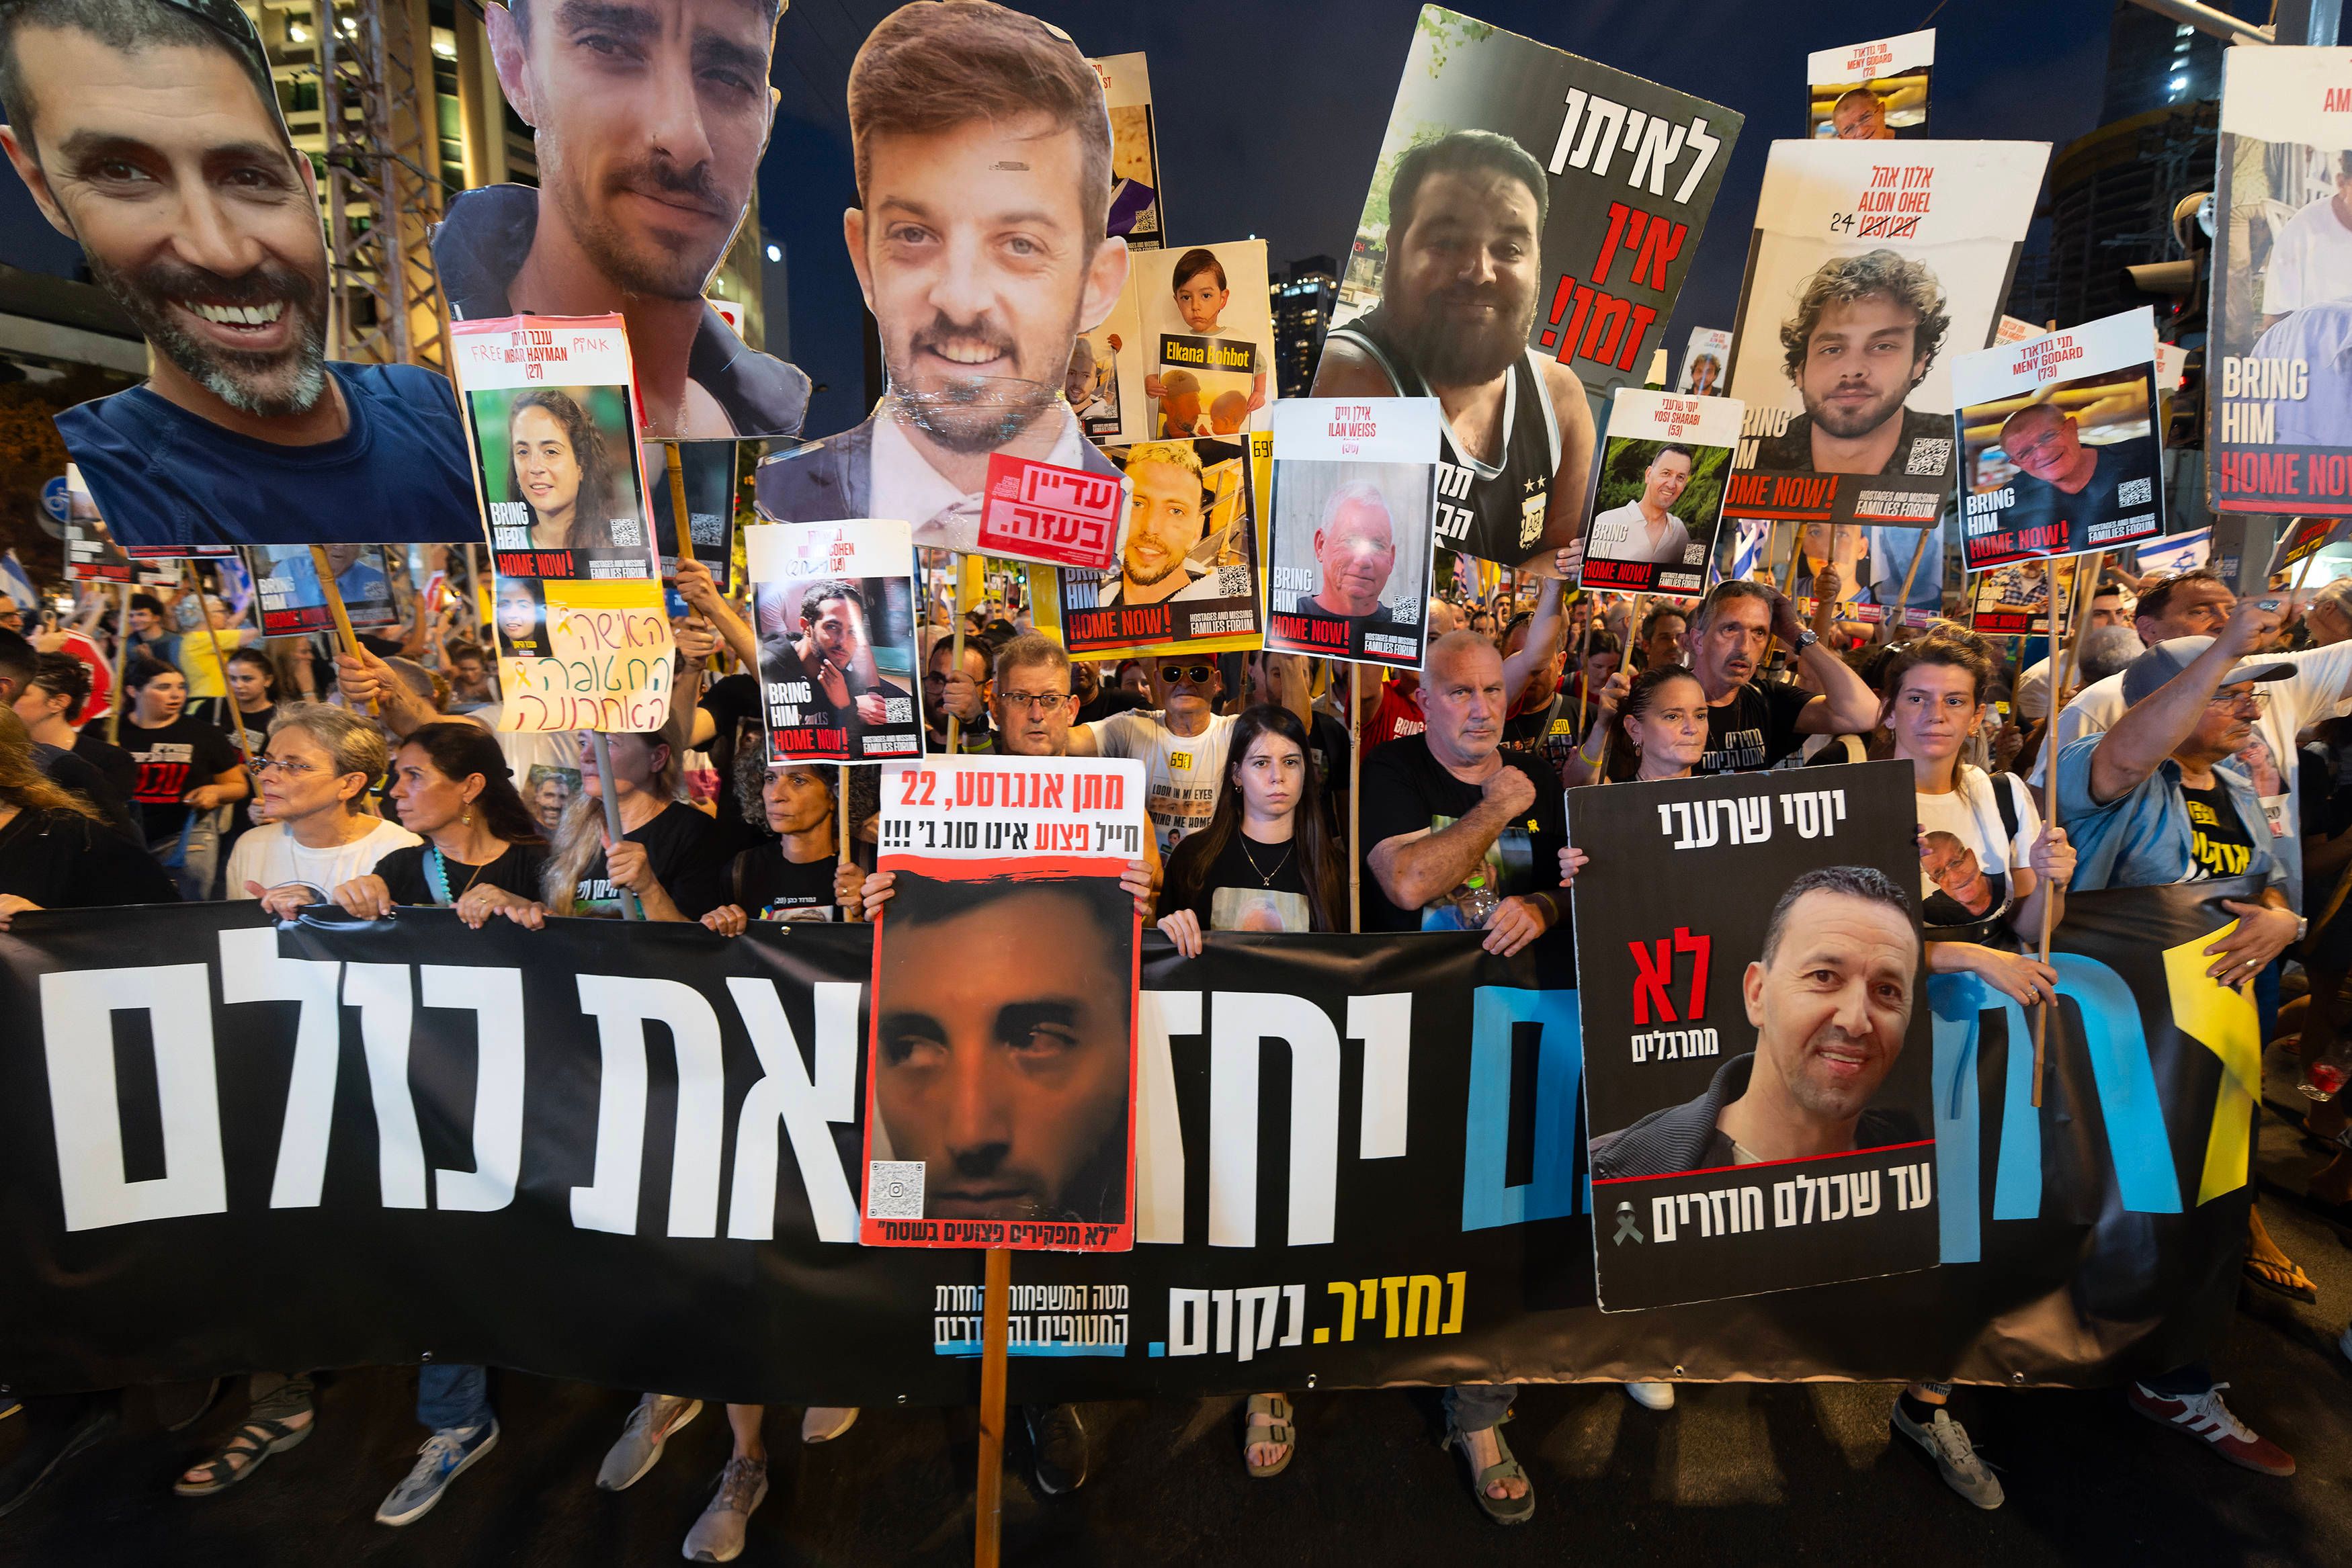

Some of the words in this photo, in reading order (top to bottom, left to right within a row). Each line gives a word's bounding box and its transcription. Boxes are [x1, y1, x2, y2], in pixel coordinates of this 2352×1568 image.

[2323, 88, 2352, 112] AM
[1548, 86, 1721, 205] לאיתן
[1870, 165, 1899, 188] אהל
[1902, 166, 1934, 189] אלון
[1857, 191, 1894, 212] ALON
[1898, 192, 1931, 212] OHEL
[1831, 212, 1855, 234] 24
[1591, 202, 1688, 292] אין
[1540, 274, 1657, 372] זמן!
[528, 331, 552, 345] ענבר
[2021, 340, 2055, 359] גודארד
[2057, 336, 2073, 349] מני
[471, 345, 502, 362] FREE
[527, 347, 568, 362] HAYMAN
[1166, 341, 1205, 363] Elkana
[1207, 345, 1250, 369] Bohbot
[2013, 357, 2040, 376] MENY
[2041, 347, 2083, 367] GODARD
[526, 363, 543, 380] (27)
[2037, 366, 2057, 382] (73)
[2222, 357, 2309, 401] BRING
[1335, 406, 1351, 421] וייס
[1353, 406, 1371, 423] אילן
[1663, 398, 1683, 411] שרעבי
[1686, 401, 1698, 412] יוסי
[1328, 423, 1347, 437] ILAN
[1349, 423, 1376, 437] WEISS
[1654, 410, 1671, 423] YOSI
[1671, 412, 1701, 425] SHARABI
[1740, 407, 1793, 438] RING
[2222, 402, 2275, 445] HIM
[1668, 424, 1683, 437] (53)
[1732, 439, 1761, 470] IM
[2221, 451, 2300, 495] HOME
[2308, 454, 2352, 496] NO
[1027, 470, 1112, 510] עדיין
[1725, 474, 1771, 505] OME
[1772, 474, 1839, 509] NOW!
[1966, 487, 2015, 517] BRING
[490, 501, 529, 525] BRING
[1855, 500, 1900, 517] FAMILIES
[1899, 502, 1937, 518] FORUM
[1000, 508, 1105, 550] בעזה.
[1592, 523, 1629, 542] BRING
[1967, 513, 1999, 537] HIM
[2089, 527, 2125, 543] FAMILIES
[2126, 520, 2156, 535] FORUM
[494, 527, 524, 550] HER
[829, 543, 855, 556] COHEN
[1587, 541, 1613, 559] HIM
[1970, 531, 2014, 559] HOME
[2018, 520, 2070, 552] NOW!
[498, 554, 535, 576] HOME
[536, 551, 575, 576] NOW!
[1584, 560, 1618, 579] HOME
[1618, 563, 1652, 582] NOW!
[1273, 567, 1313, 592] BRING
[1658, 578, 1681, 586] FAMILIES
[1681, 579, 1701, 589] FORUM
[1066, 582, 1100, 610] HIM
[1273, 590, 1298, 614] HIM
[1069, 611, 1118, 640] HOME
[1123, 603, 1173, 635] NOW!
[1189, 612, 1217, 622] HOSTAGES
[1217, 611, 1229, 621] AND
[1228, 609, 1253, 619] MISSING
[1190, 621, 1225, 634] FAMILIES
[1226, 618, 1254, 632] FORUM
[574, 609, 664, 650] האישה
[1271, 615, 1308, 642] HOME
[1312, 620, 1349, 646] NOW!
[1365, 640, 1394, 654] FAMILIES
[1394, 644, 1417, 657] FORUM
[768, 681, 812, 705] BRING
[515, 695, 664, 731] האחרונה
[770, 705, 799, 727] HIM
[774, 729, 814, 752] HOME
[816, 727, 849, 752] NOW!
[1702, 750, 1740, 769] הביתה
[900, 771, 937, 805] 22
[1073, 774, 1124, 813] מתן
[1152, 784, 1171, 797] LOOK
[1194, 789, 1212, 799] EYES
[1173, 816, 1185, 828] ME
[1657, 795, 1773, 851] שרעבי
[1779, 789, 1847, 838] יוסי
[941, 822, 978, 849] סוג
[985, 822, 1028, 850] אינו
[1034, 823, 1089, 851] פצוע
[1095, 822, 1139, 852] חייל
[1628, 926, 1711, 1025] לא
[1631, 1028, 1720, 1063] מתרגלים
[39, 926, 526, 1232] כולם
[570, 973, 863, 1243] את
[1773, 1170, 1882, 1228] שכולם
[1888, 1162, 1932, 1211] עד
[1652, 1186, 1765, 1244] חוזרים
[943, 1222, 1005, 1243] פצועים
[1010, 1223, 1080, 1245] מפקירים
[1093, 1285, 1129, 1309] מטה
[1313, 1271, 1467, 1344] נחזיר.
[935, 1315, 1031, 1346] והדרים
[1038, 1314, 1128, 1346] החטופים
[1148, 1284, 1306, 1362] נקום.
